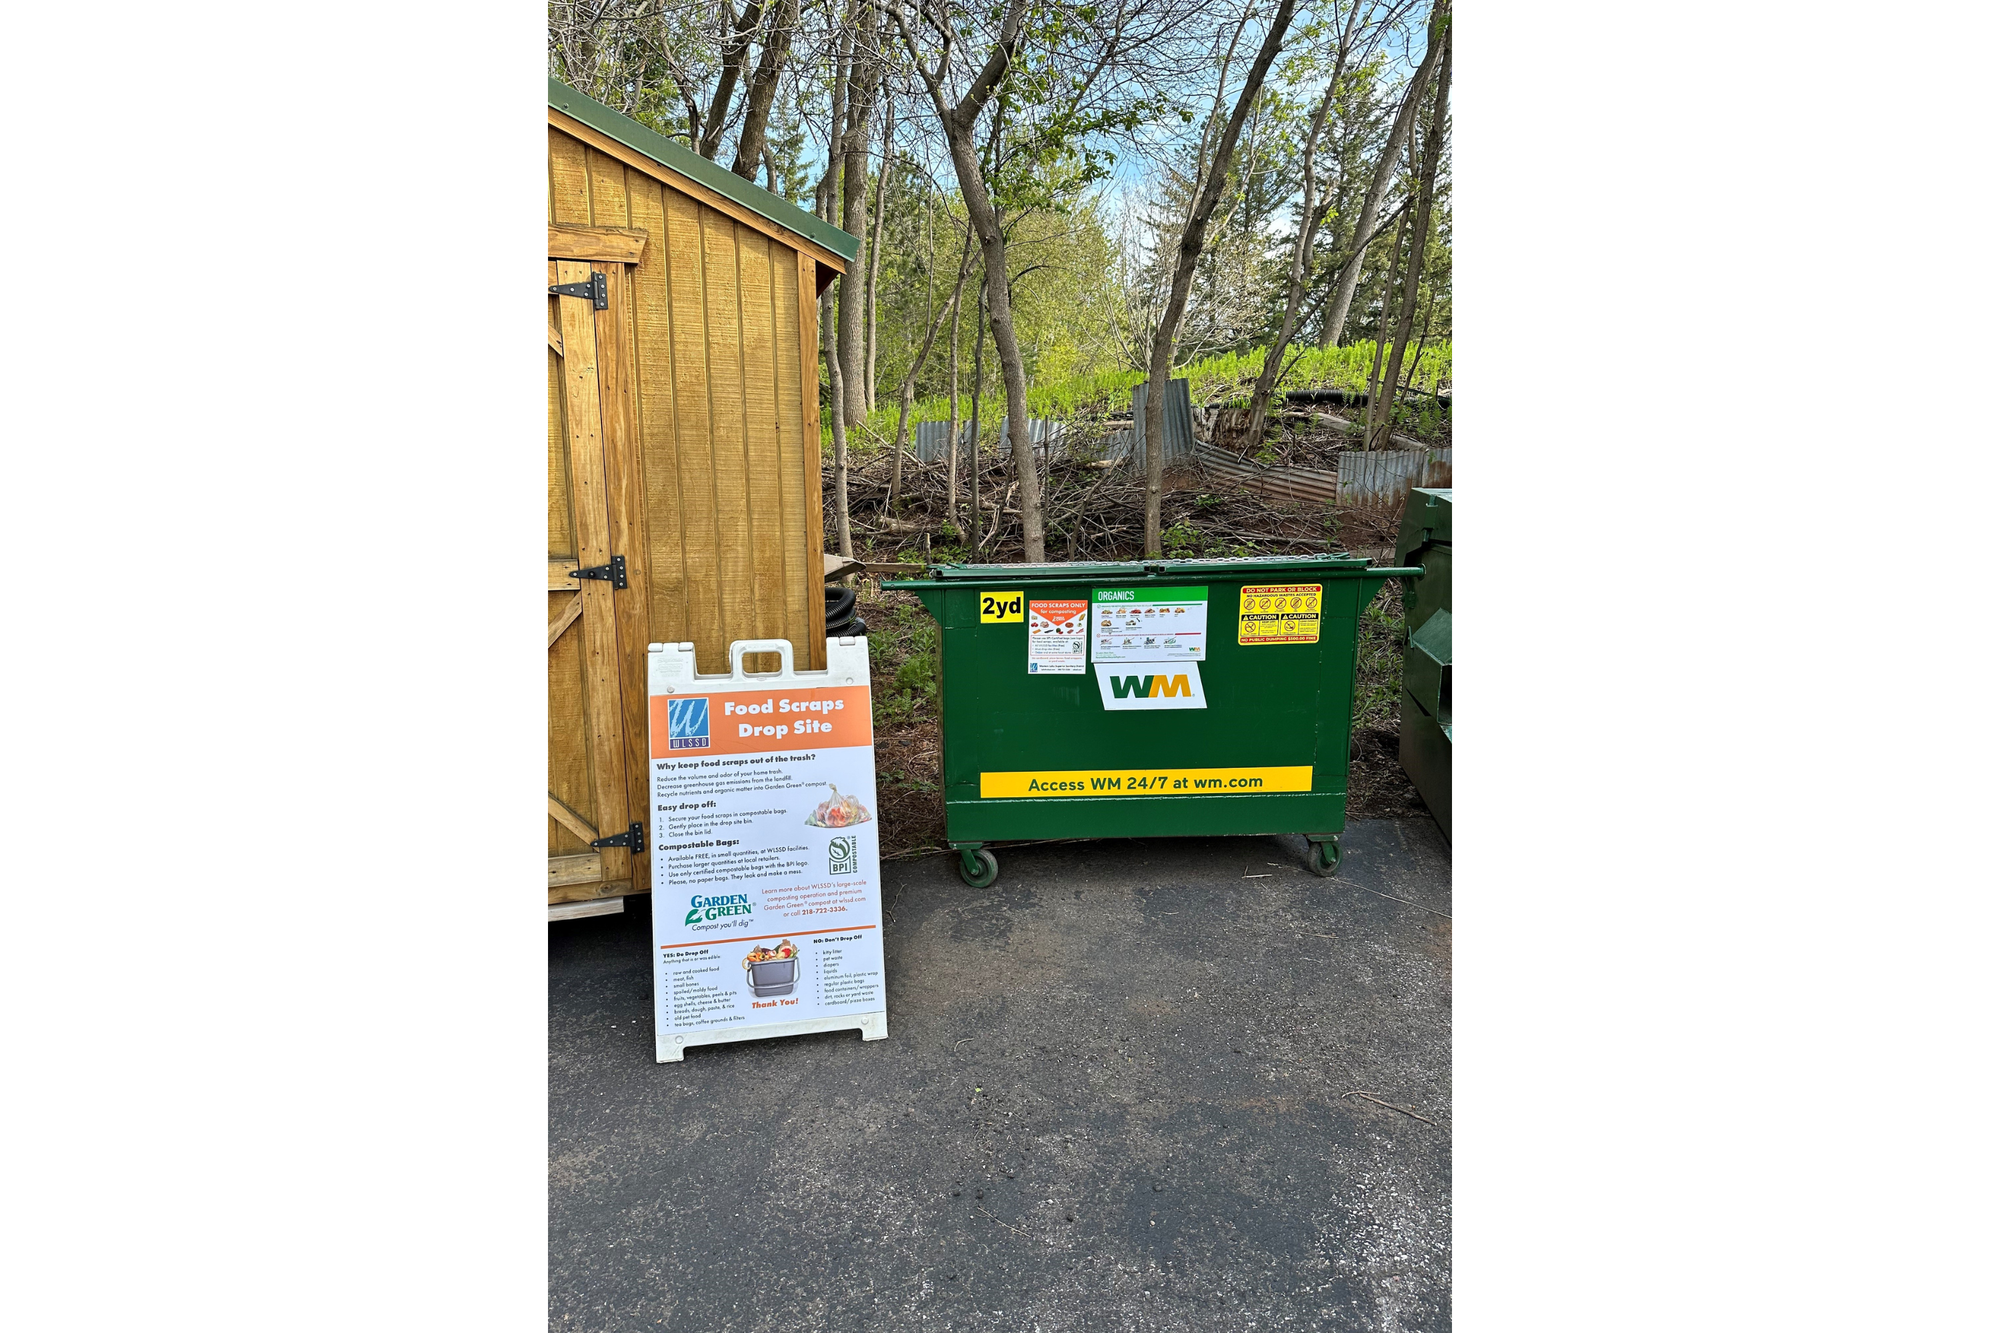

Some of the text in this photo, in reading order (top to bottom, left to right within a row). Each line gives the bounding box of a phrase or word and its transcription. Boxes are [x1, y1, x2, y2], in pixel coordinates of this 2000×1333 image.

[1098, 591, 1134, 600] ORGANICS
[982, 597, 1021, 618] 2yd
[1110, 674, 1192, 698] WM
[725, 699, 844, 715] Food Scraps
[738, 720, 832, 739] Drop Site
[673, 738, 707, 748] WLSSD
[1028, 777, 1263, 792] Access WM 24/7 at wm.com
[659, 840, 714, 851] Compostable
[833, 863, 848, 872] BPI
[691, 894, 747, 908] GARDEN
[767, 894, 798, 903] composting
[802, 906, 848, 915] 218-722-3336.
[720, 920, 737, 930] you'll
[752, 998, 798, 1009] Thank You!
